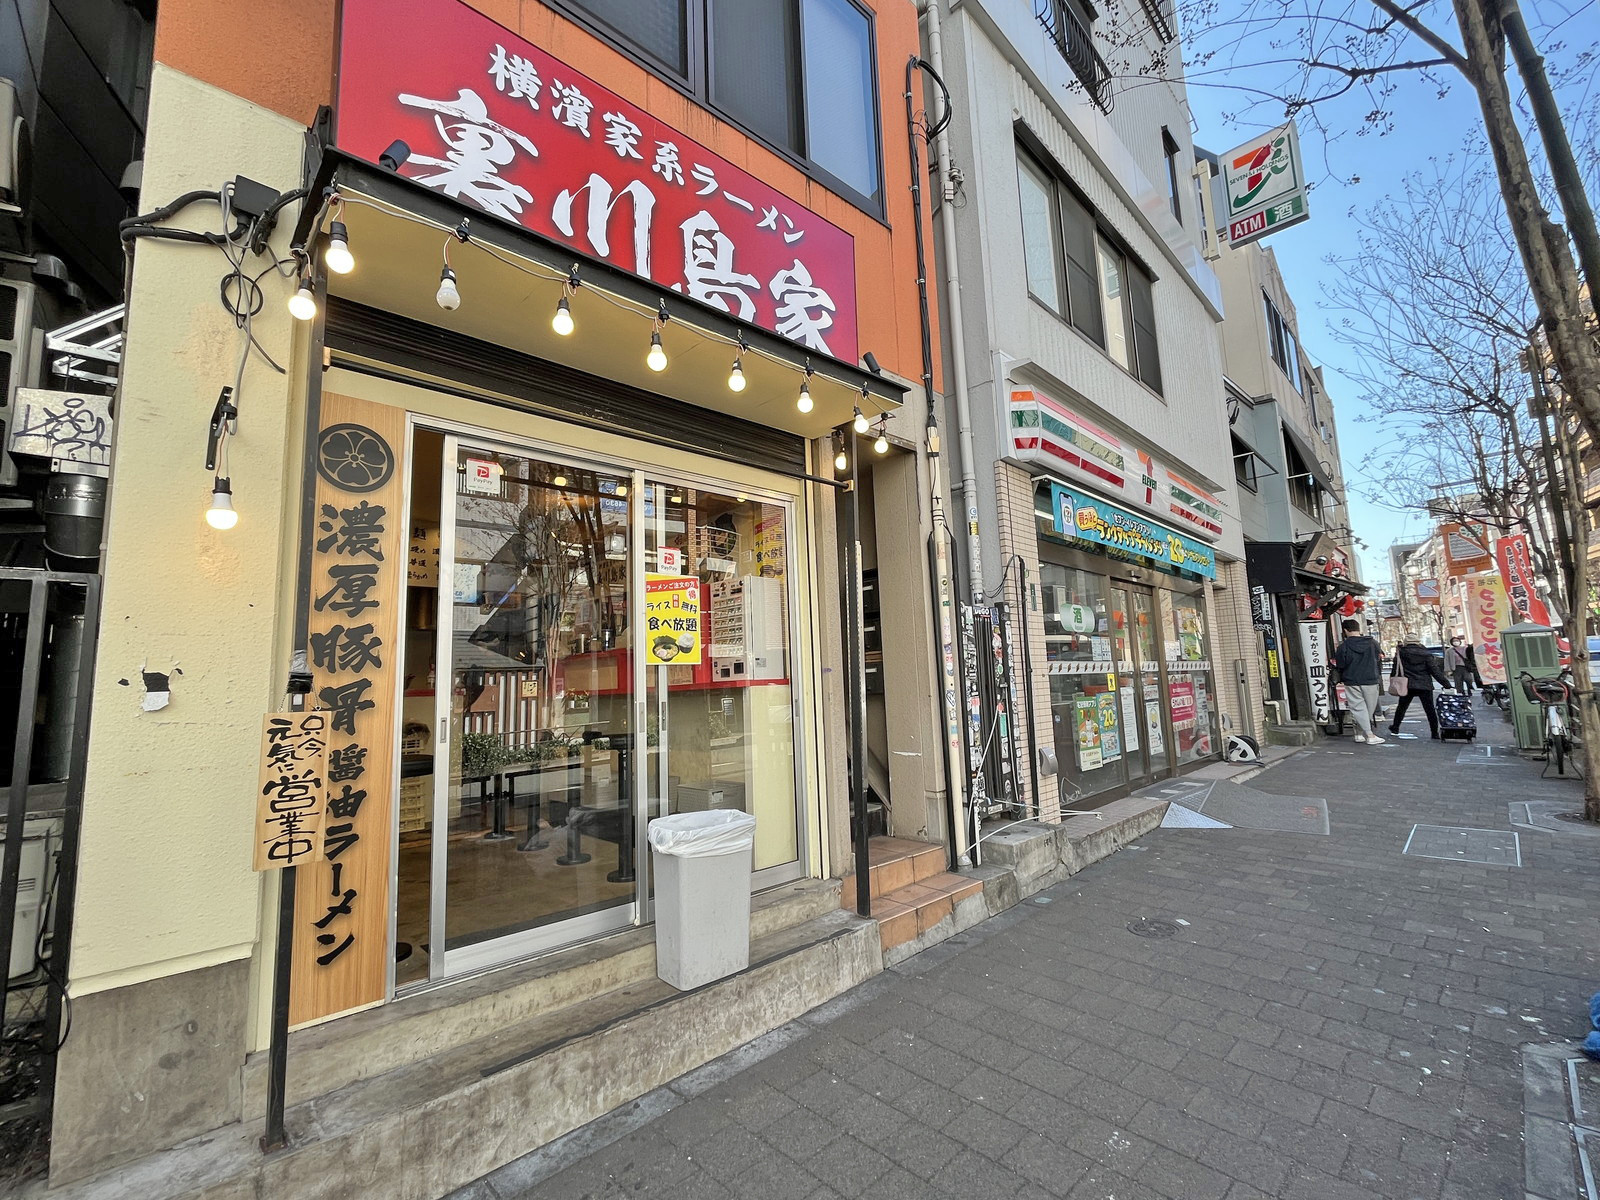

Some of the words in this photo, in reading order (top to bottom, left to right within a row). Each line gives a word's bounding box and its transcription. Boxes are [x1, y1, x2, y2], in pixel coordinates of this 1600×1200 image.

[487, 43, 805, 244] 横濱家系ラーメン
[1229, 173, 1248, 185] SEVEN
[1256, 154, 1289, 173] HOLDINGS
[1273, 200, 1293, 222] 酒
[1234, 214, 1262, 238] ATM
[646, 601, 671, 611] ライス
[681, 600, 698, 614] 無料
[647, 616, 698, 632] 食べ放題
[1308, 624, 1329, 721] 昔ながらの皿うどん
